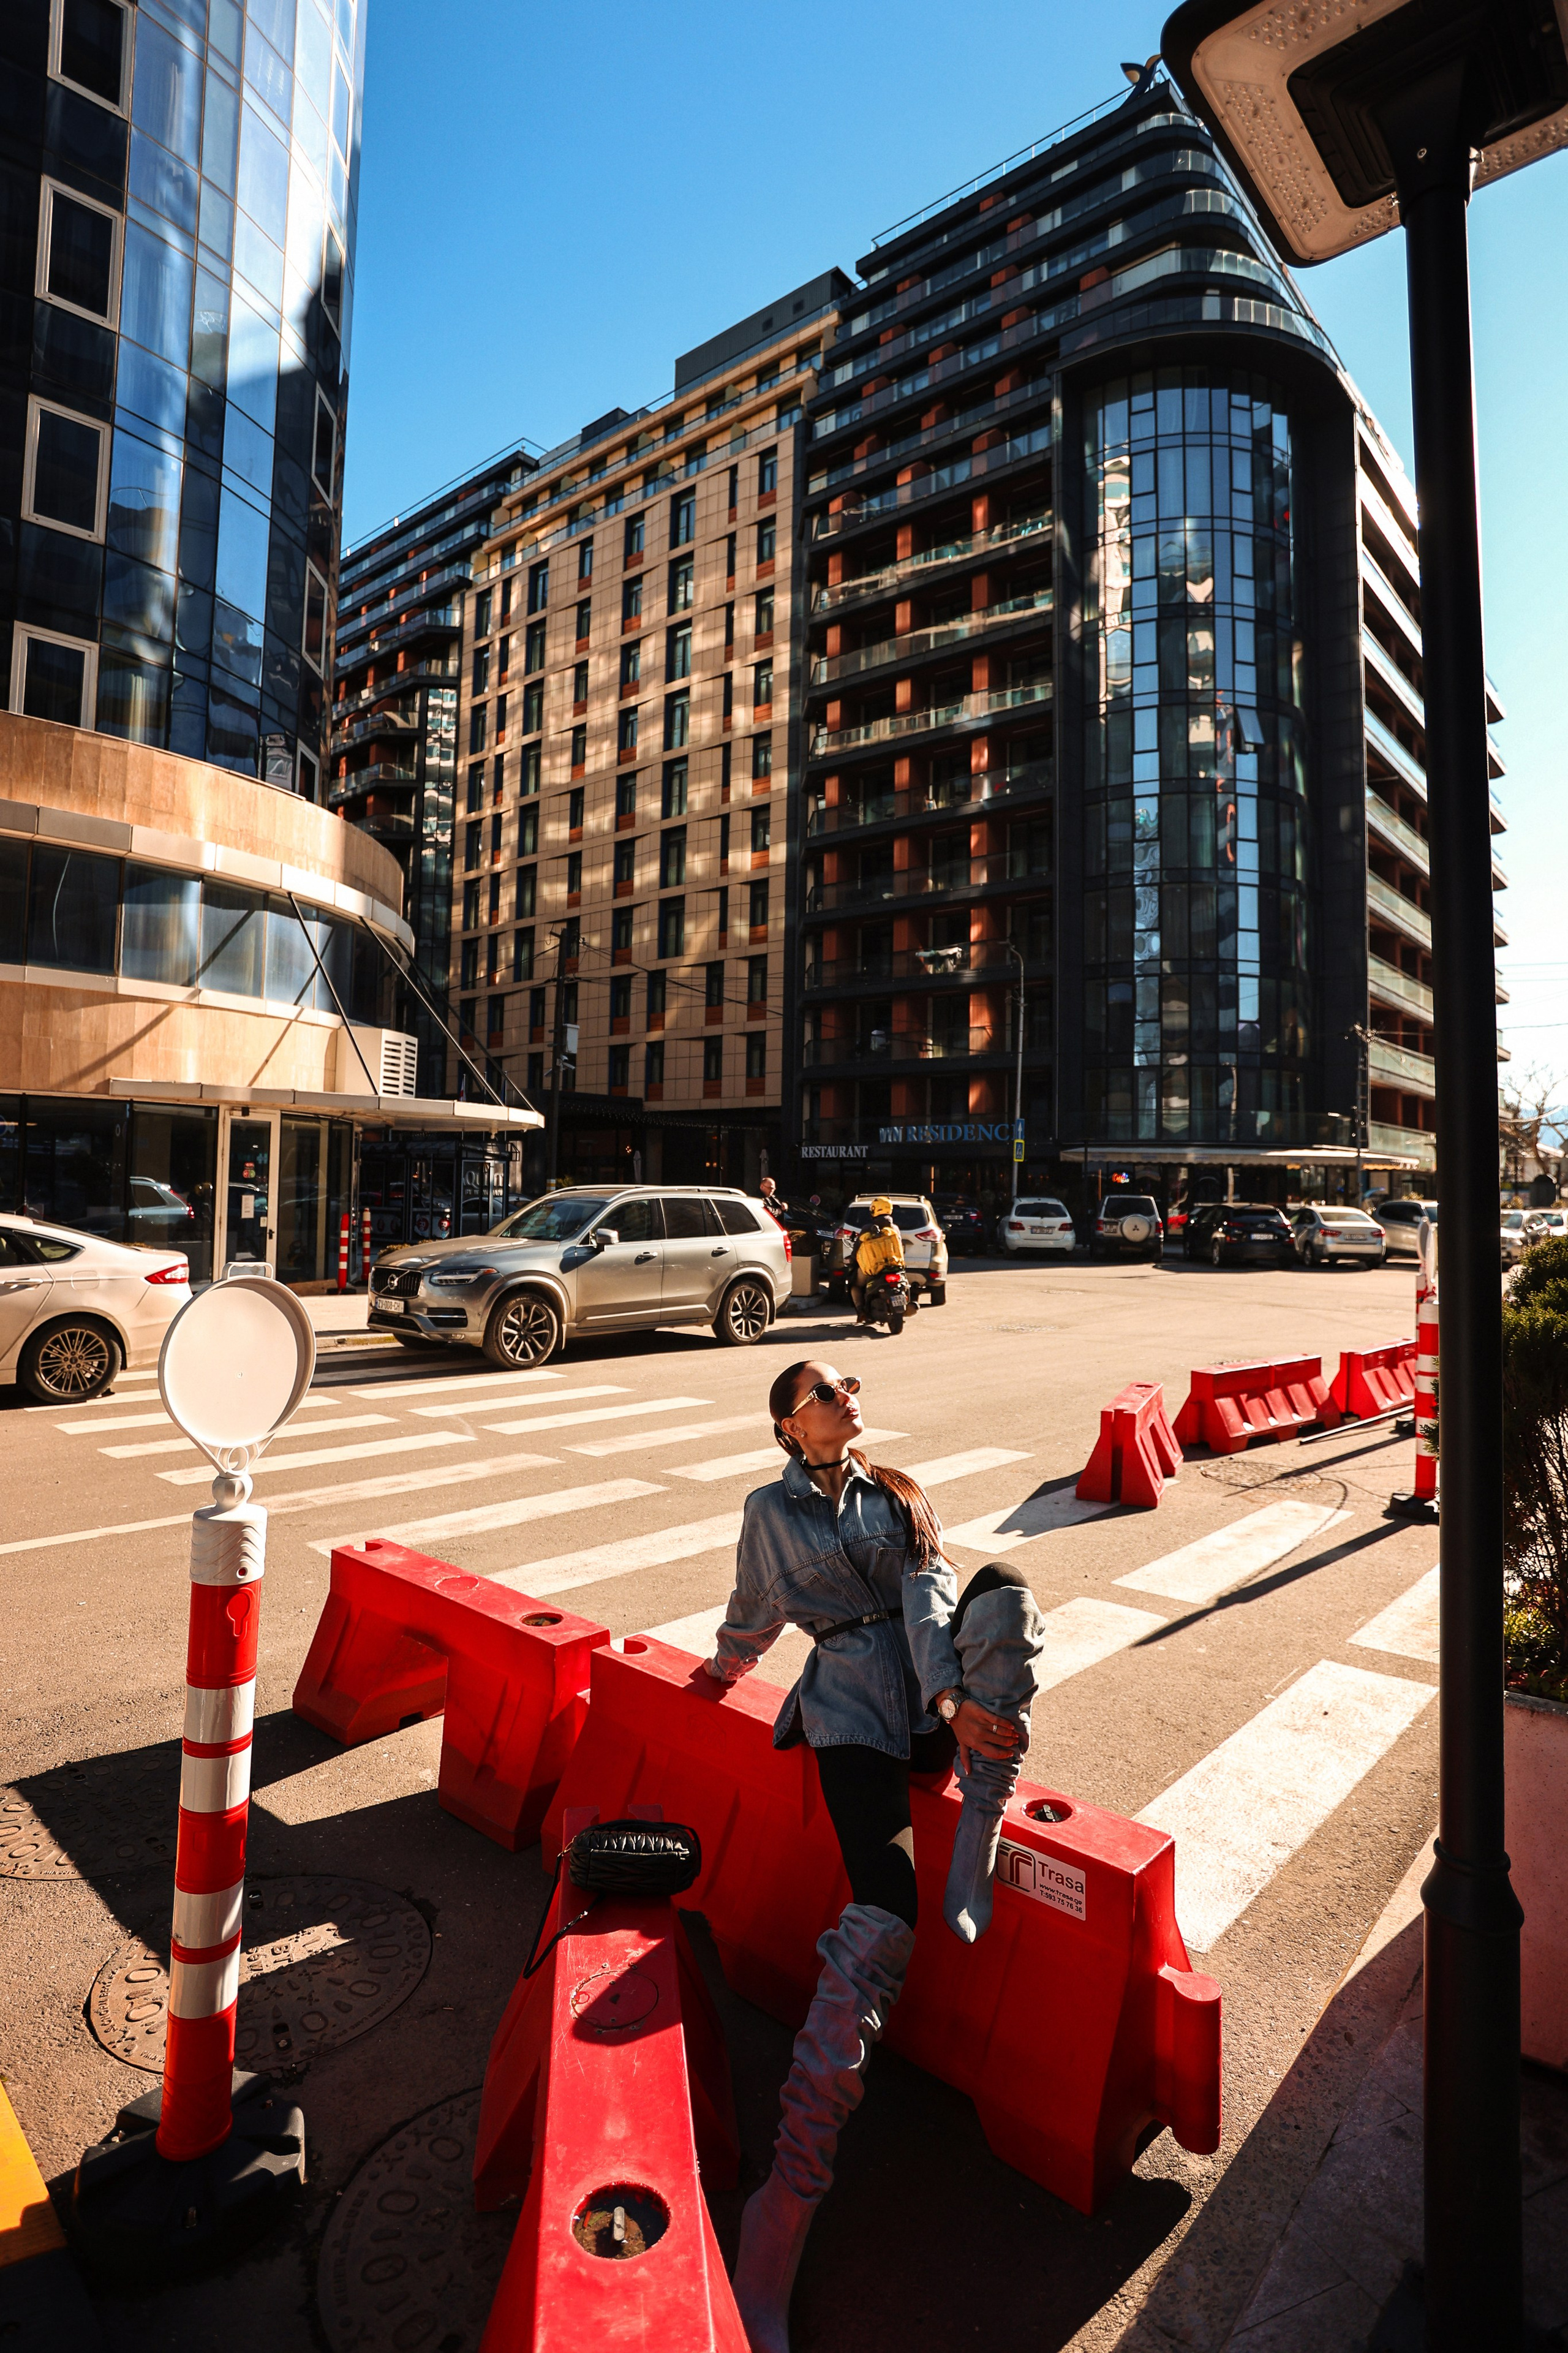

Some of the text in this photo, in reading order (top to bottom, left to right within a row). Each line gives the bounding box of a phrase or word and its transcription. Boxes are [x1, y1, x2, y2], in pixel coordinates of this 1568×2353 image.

[906, 1124, 1024, 1142] RESIDENC
[801, 1146, 869, 1158] RESTAURANT
[1038, 1860, 1084, 1895] Trasa
[1039, 1883, 1083, 1905] www.trasa.ge
[1040, 1889, 1056, 1902] T:593
[1057, 1897, 1065, 1906] 75
[1075, 1905, 1083, 1914] 36
